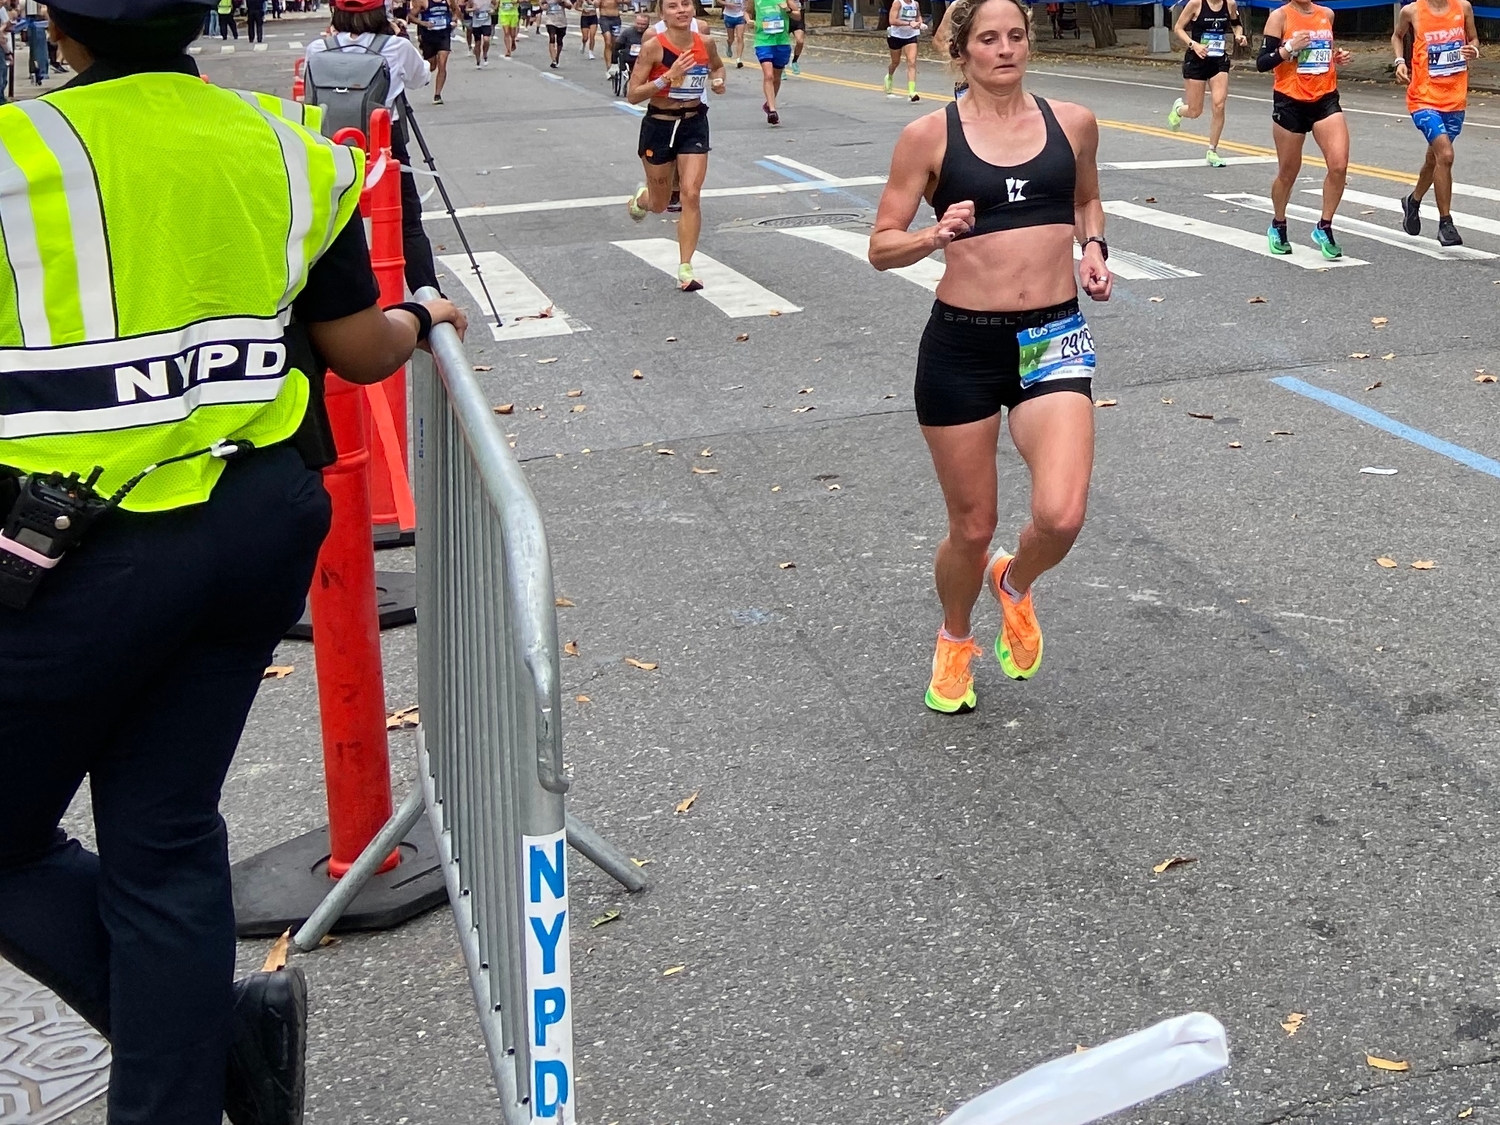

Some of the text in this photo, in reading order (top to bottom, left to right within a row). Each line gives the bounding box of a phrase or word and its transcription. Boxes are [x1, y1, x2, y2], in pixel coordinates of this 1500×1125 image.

[1424, 27, 1464, 42] STRAVA
[690, 76, 706, 88] 2247
[115, 342, 287, 403] NYPD
[529, 838, 568, 1118] NYPD
